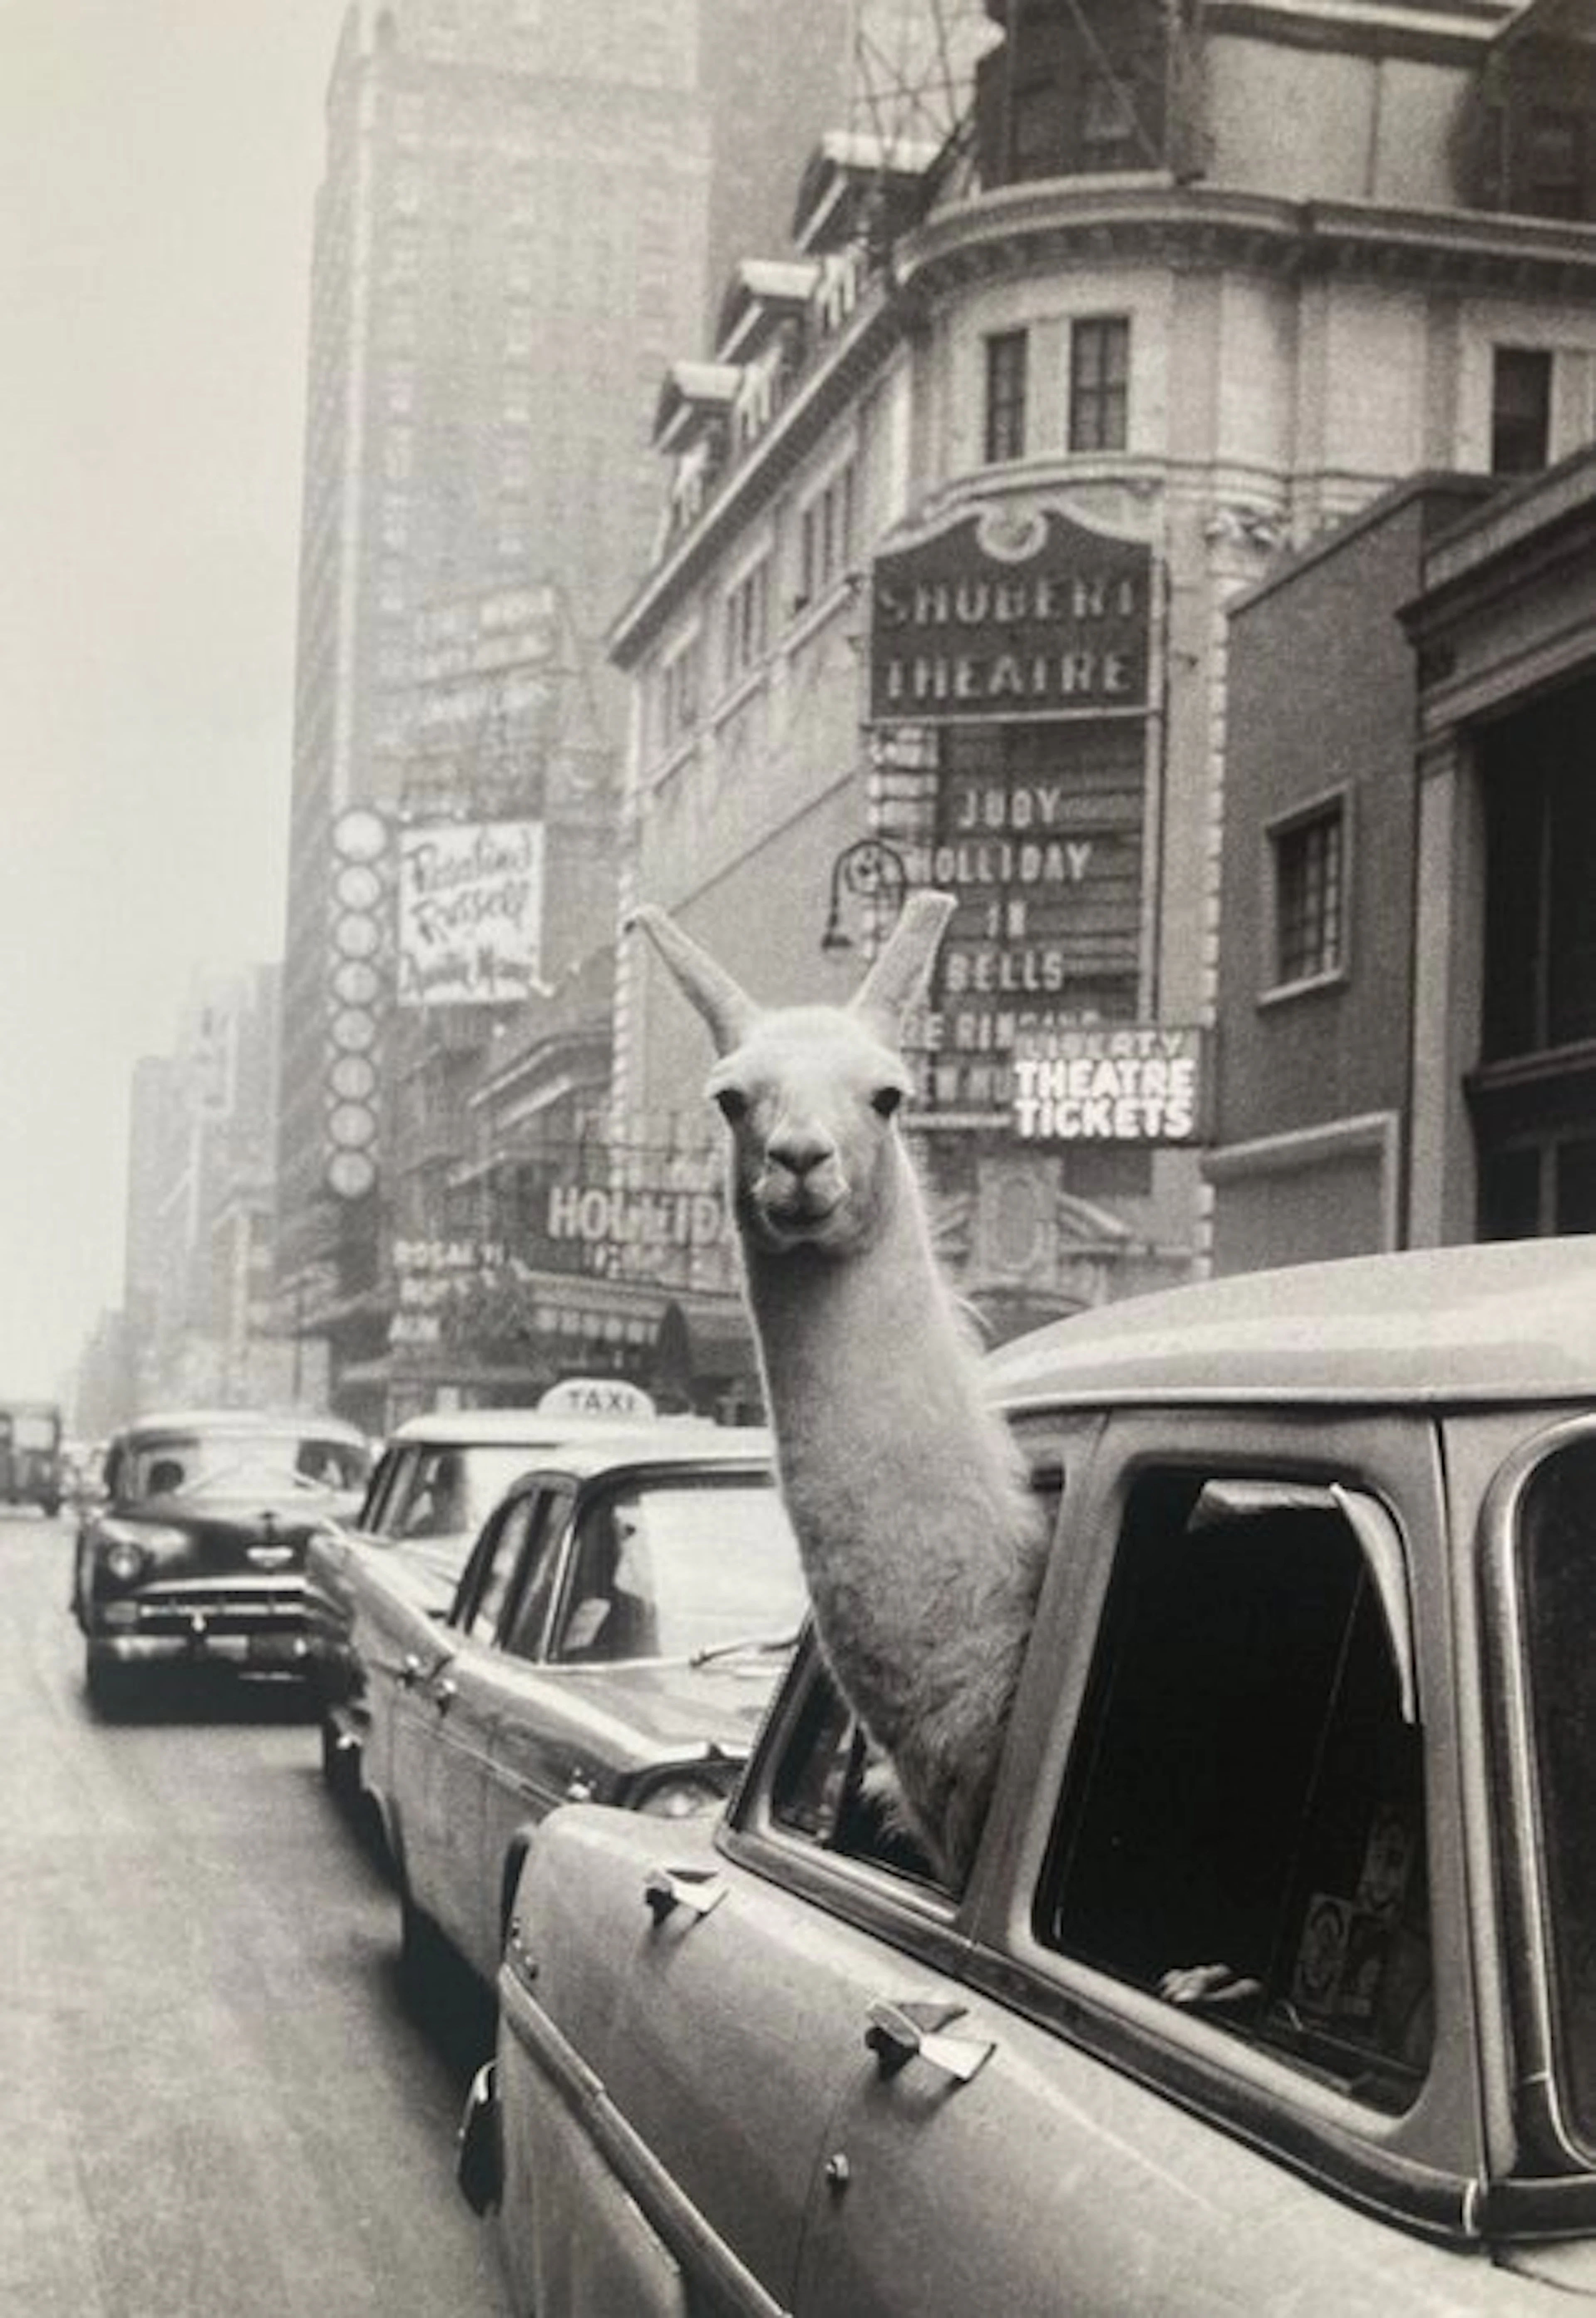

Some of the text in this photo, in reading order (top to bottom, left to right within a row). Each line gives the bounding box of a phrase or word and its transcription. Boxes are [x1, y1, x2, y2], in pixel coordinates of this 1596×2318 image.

[877, 578, 1137, 624] SHUBERT
[884, 653, 1130, 698] THEATRE
[958, 786, 1061, 828] JUDY
[904, 842, 1093, 883] HOLLIDAY
[947, 951, 1064, 991] BELLS
[1013, 1058, 1195, 1099] THEATRE
[1013, 1098, 1194, 1138] TICKETS
[567, 1389, 635, 1411] TAXI
